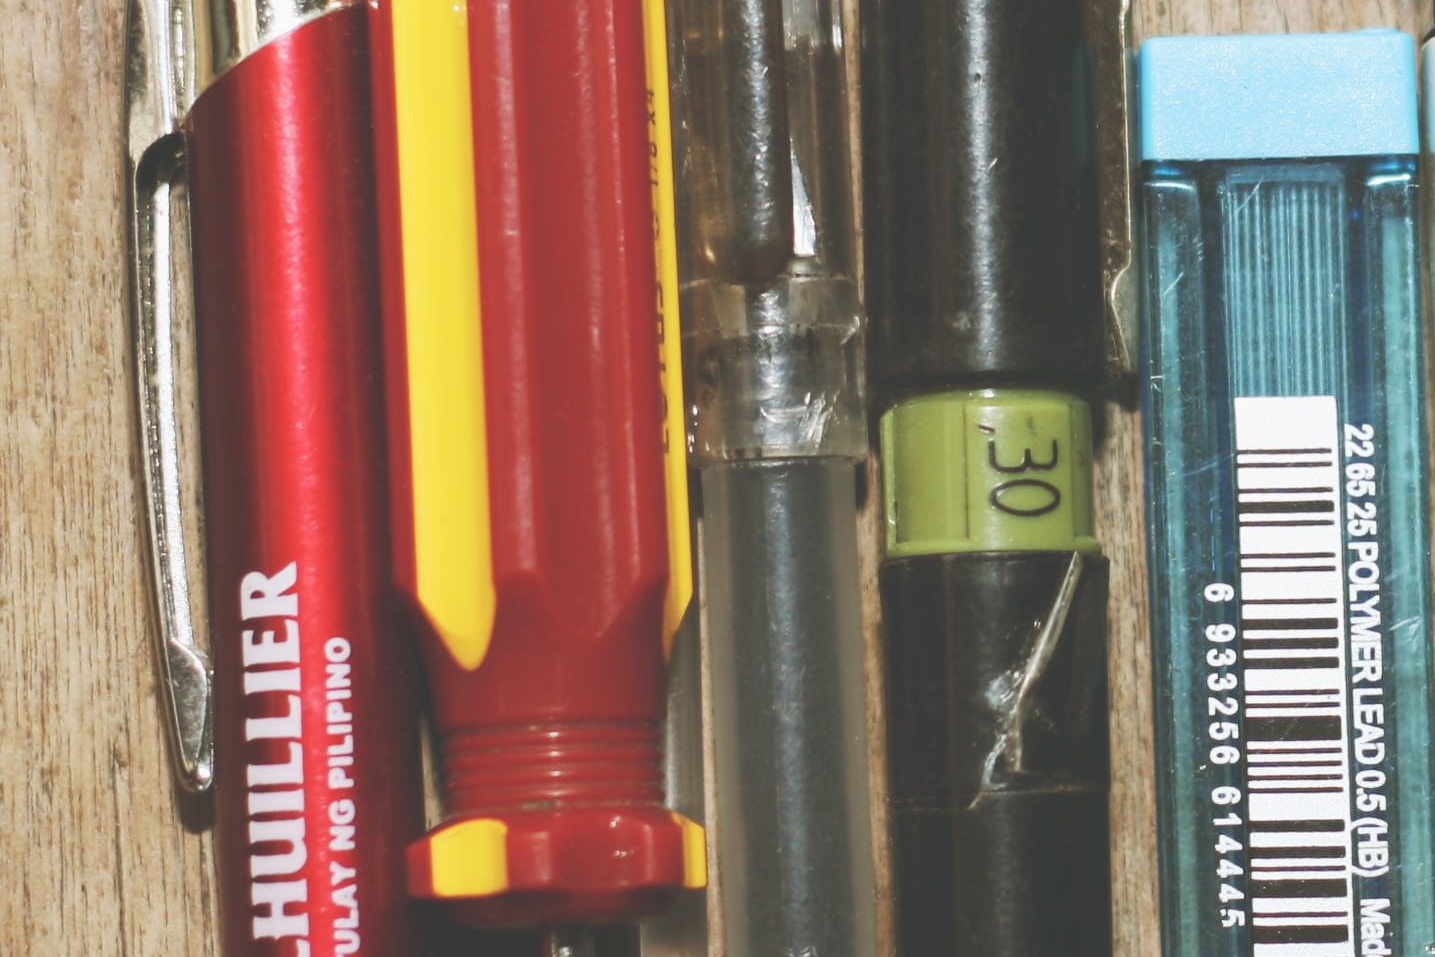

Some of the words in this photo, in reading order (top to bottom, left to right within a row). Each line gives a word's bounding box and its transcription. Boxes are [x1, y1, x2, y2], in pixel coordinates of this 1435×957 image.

[1344, 423, 1374, 458] 22
[1345, 462, 1376, 497] 65
[1346, 502, 1377, 537] 25
[1203, 582, 1235, 602] 6
[1347, 541, 1383, 683] POLYMER
[324, 636, 354, 789] PILIPINO
[1205, 623, 1240, 765] 933256
[1352, 687, 1386, 765] LEAD
[1354, 769, 1387, 812] 0.5
[328, 798, 356, 851] NG
[1349, 816, 1390, 878] (HB)
[1211, 785, 1245, 928] 614445
[329, 860, 360, 957] ULAY
